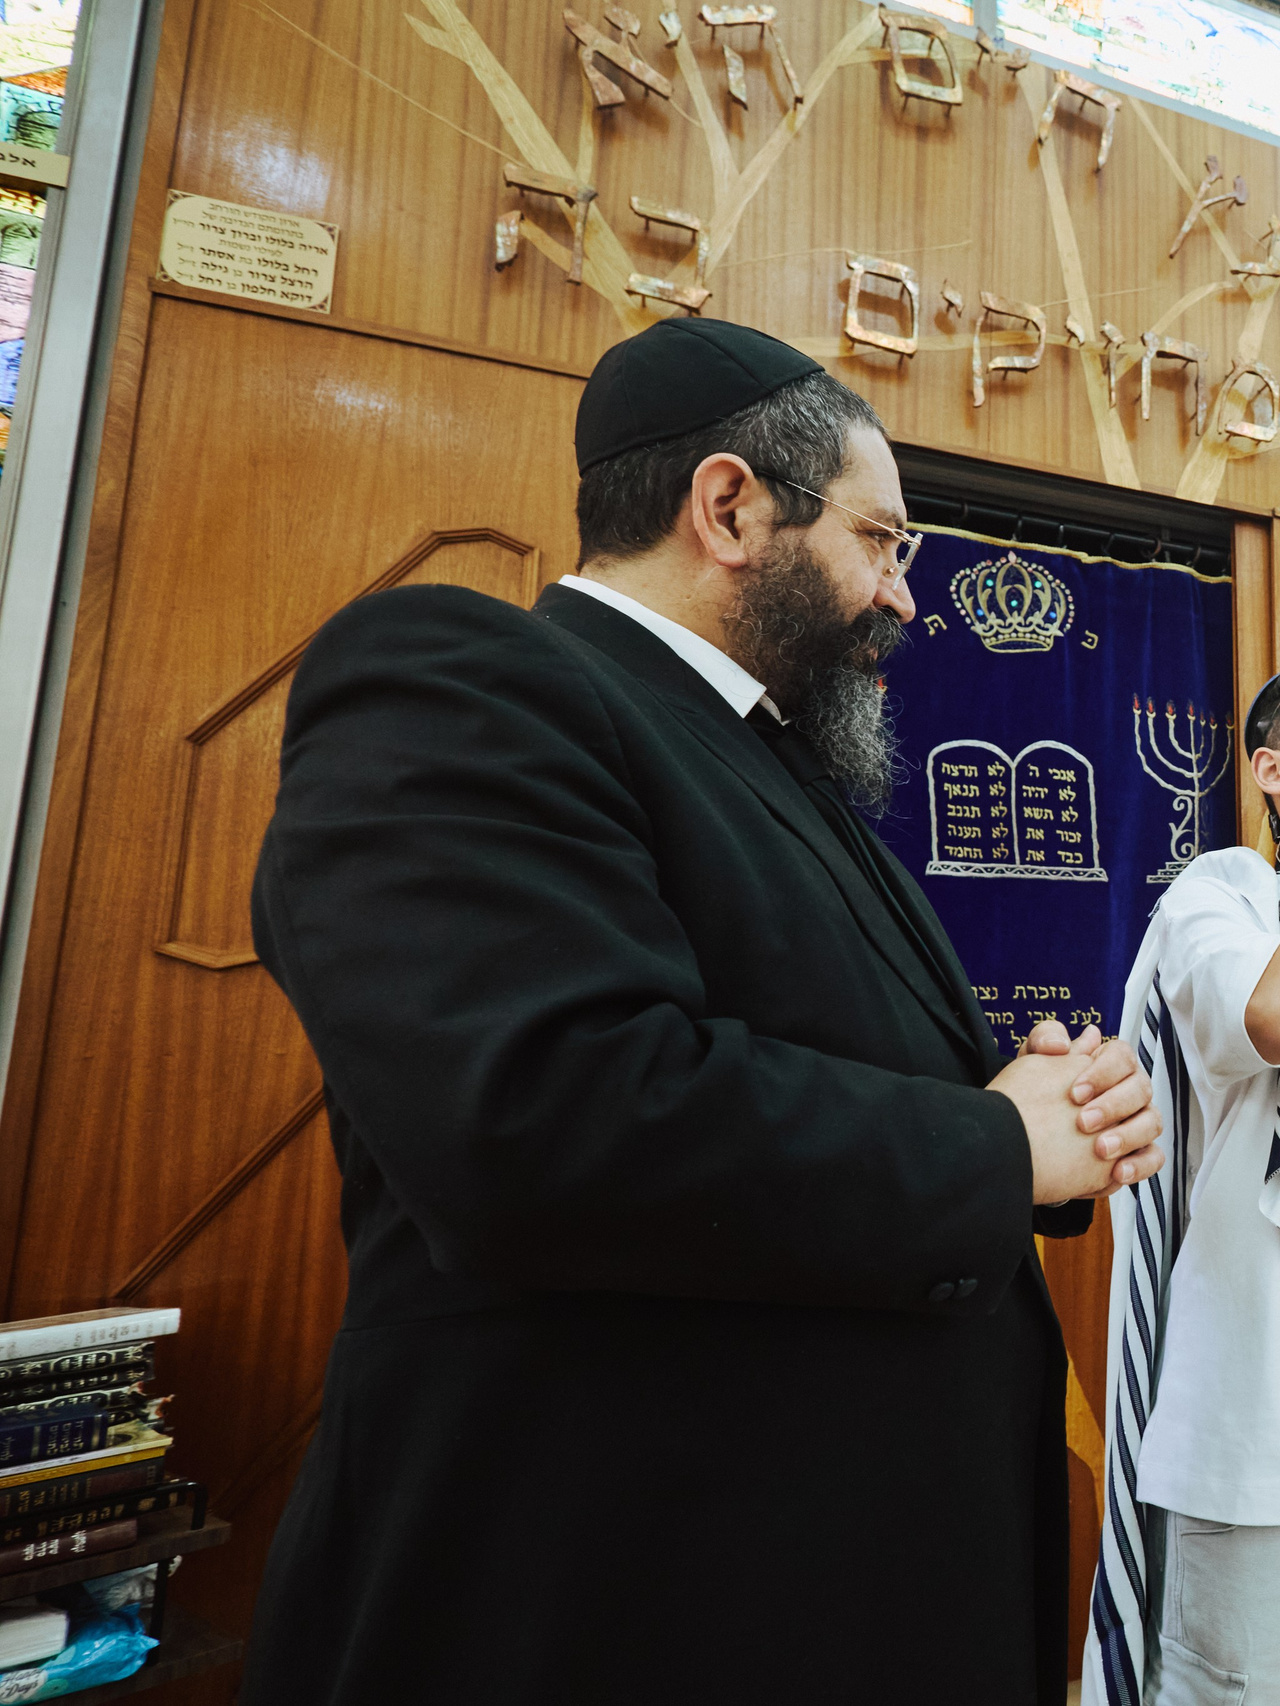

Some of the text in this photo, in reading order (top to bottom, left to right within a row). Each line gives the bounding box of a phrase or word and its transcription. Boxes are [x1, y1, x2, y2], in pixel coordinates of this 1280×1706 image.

[199, 222, 226, 235] צרור
[230, 229, 261, 242] וברוך
[265, 235, 294, 249] בלולו
[299, 243, 328, 255] אריה
[199, 247, 235, 261] אסתר
[258, 257, 289, 272] בלולו
[294, 264, 318, 277] רחל
[198, 275, 222, 287] רחל
[248, 271, 276, 283] צרור
[280, 276, 313, 290] הרצל
[942, 761, 1006, 777] לא תרצח
[1048, 769, 1076, 782] אנכי
[944, 781, 1006, 799] לא תנאף
[1022, 785, 1076, 801] לא יהיה
[948, 801, 1007, 818] לא תגנב
[1024, 806, 1078, 822] לא תשא
[948, 823, 1008, 838] לא תענה
[1026, 828, 1081, 842] זכור את
[945, 843, 1008, 858] לא תחמד
[1026, 850, 1083, 863] כבד את
[1013, 985, 1071, 999] מזכרת
[985, 1011, 1015, 1025] מור
